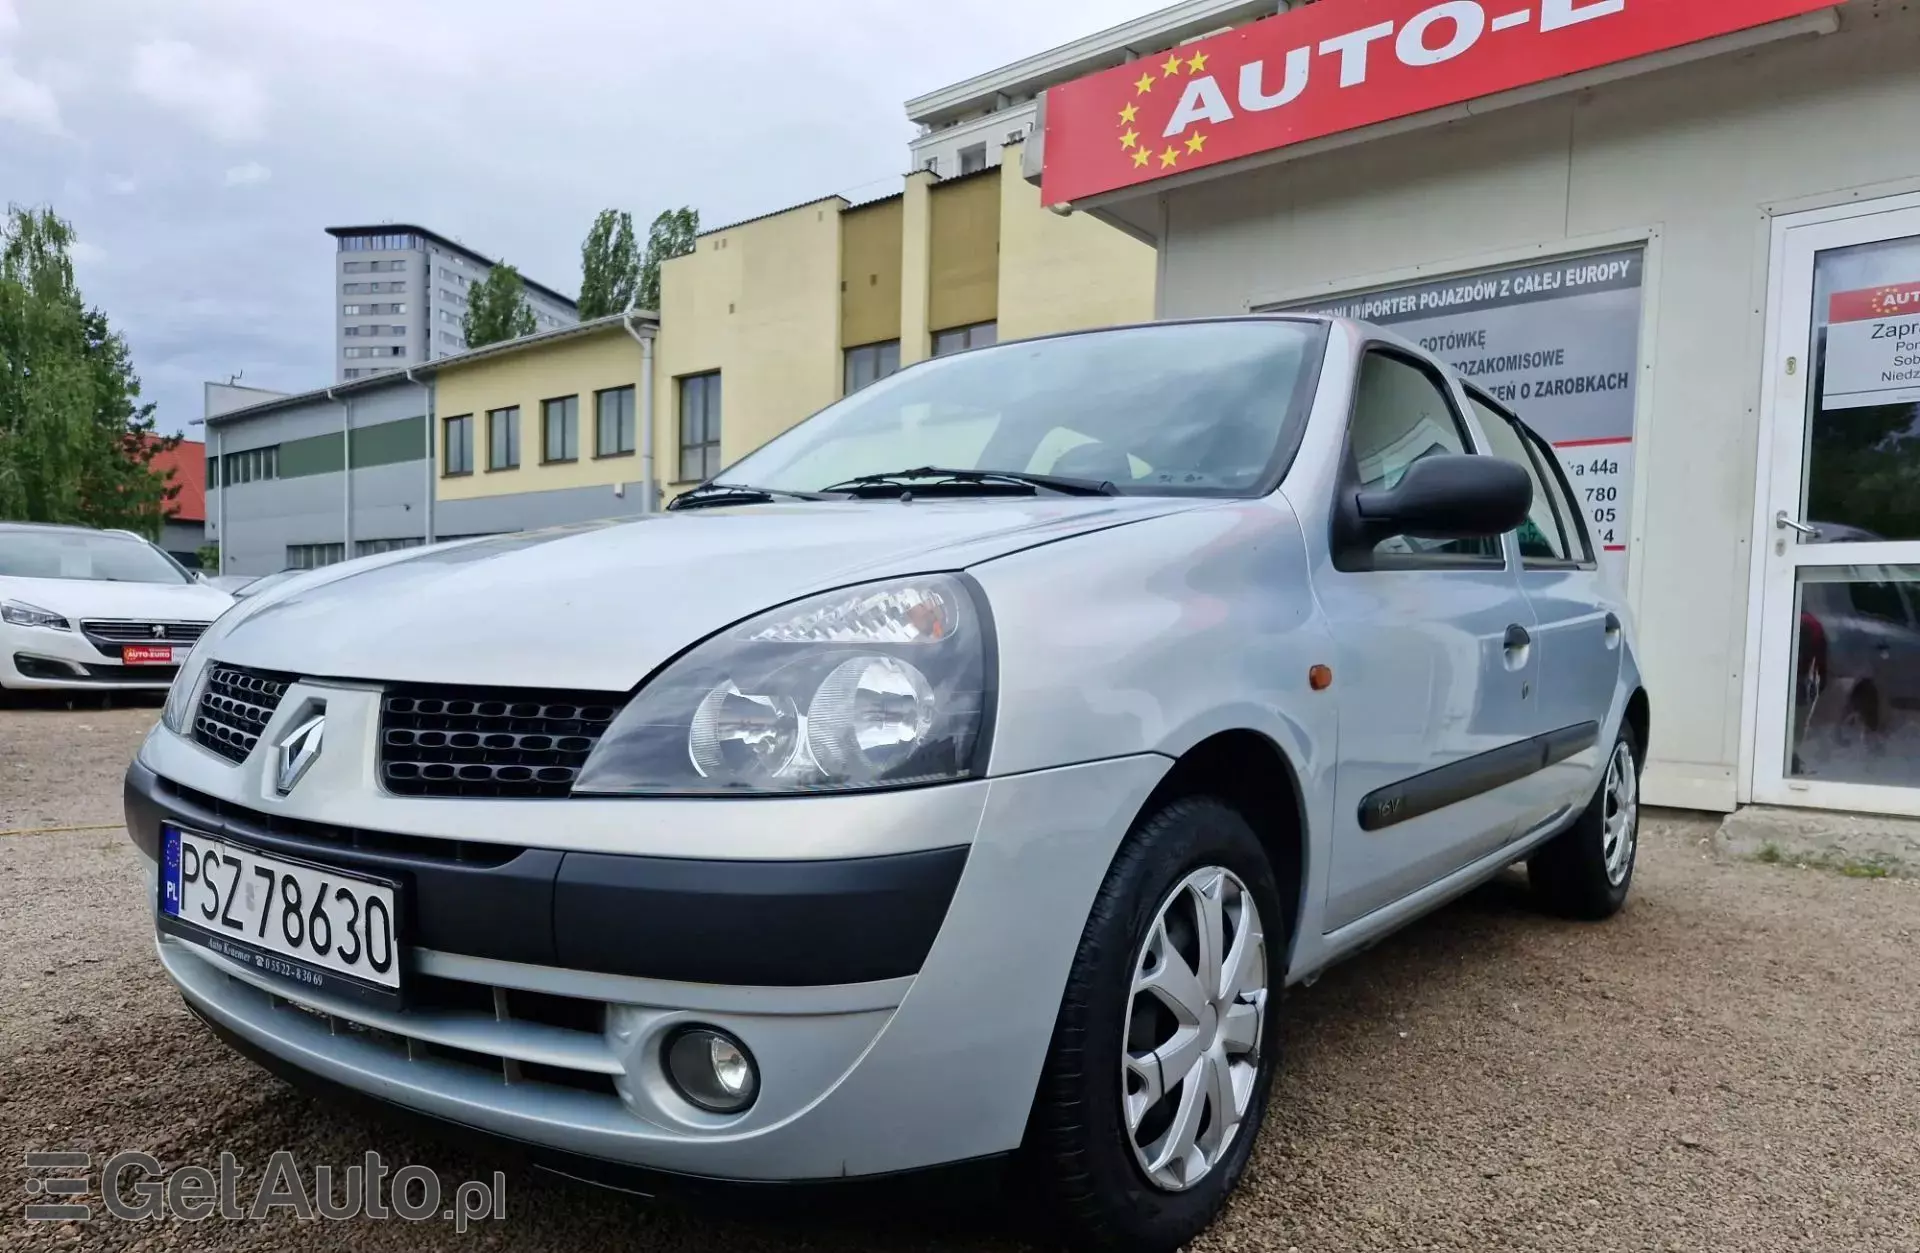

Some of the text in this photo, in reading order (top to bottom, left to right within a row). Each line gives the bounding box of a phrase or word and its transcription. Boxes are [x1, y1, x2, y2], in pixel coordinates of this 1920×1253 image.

[1350, 295, 1417, 319] IMPORTER
[1420, 281, 1497, 309] POJAZDÓW
[1500, 279, 1511, 297] Z
[1514, 271, 1561, 295] CAŁEJ
[1566, 260, 1631, 287] EUROPY
[1419, 330, 1487, 351] GOTÓWKĘ
[1871, 322, 1920, 339] Zapr
[1451, 349, 1565, 377] OZAKOMISOWE
[1520, 383, 1530, 400] O
[1535, 372, 1629, 398] ZAROBKACH
[1590, 458, 1618, 475] 44a
[1585, 487, 1617, 503] 780
[1378, 798, 1399, 816] 16V
[167, 881, 178, 901] PL
[181, 842, 392, 974] PSZ 78630
[208, 938, 223, 953] Auto
